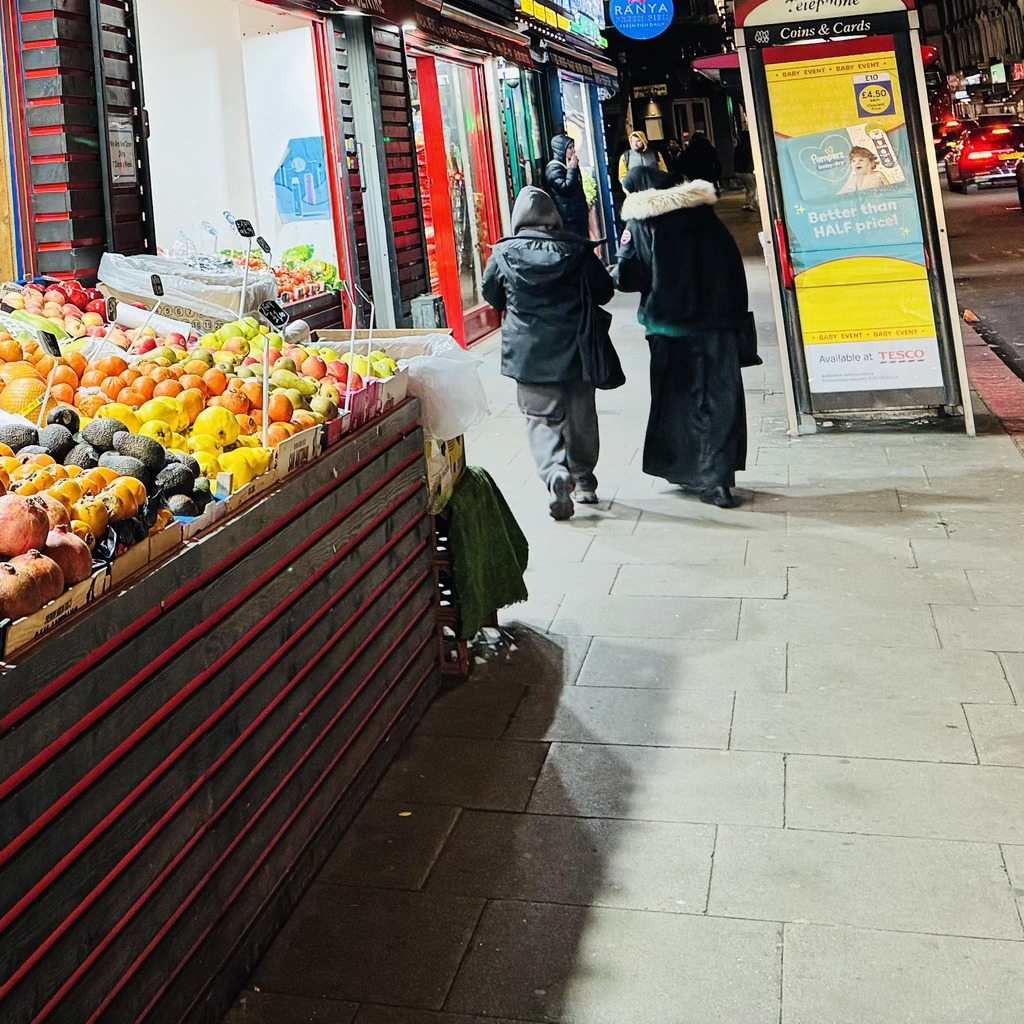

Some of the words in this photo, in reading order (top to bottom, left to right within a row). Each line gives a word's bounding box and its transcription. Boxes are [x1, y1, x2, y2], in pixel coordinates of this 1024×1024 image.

[614, 3, 668, 15] RANYA
[780, 26, 815, 39] Coins
[818, 23, 830, 36] &
[833, 20, 871, 34] Cards
[782, 69, 802, 77] BABY
[804, 67, 825, 76] EVENT
[836, 64, 854, 72] BABY
[858, 61, 880, 70] EVENT
[862, 89, 887, 98] £4.50
[807, 206, 857, 224] Better
[860, 200, 897, 213] than
[813, 224, 852, 239] HALF
[855, 214, 898, 234] price!
[819, 353, 861, 364] Available
[863, 353, 873, 361] at
[878, 349, 925, 360] TESCO
